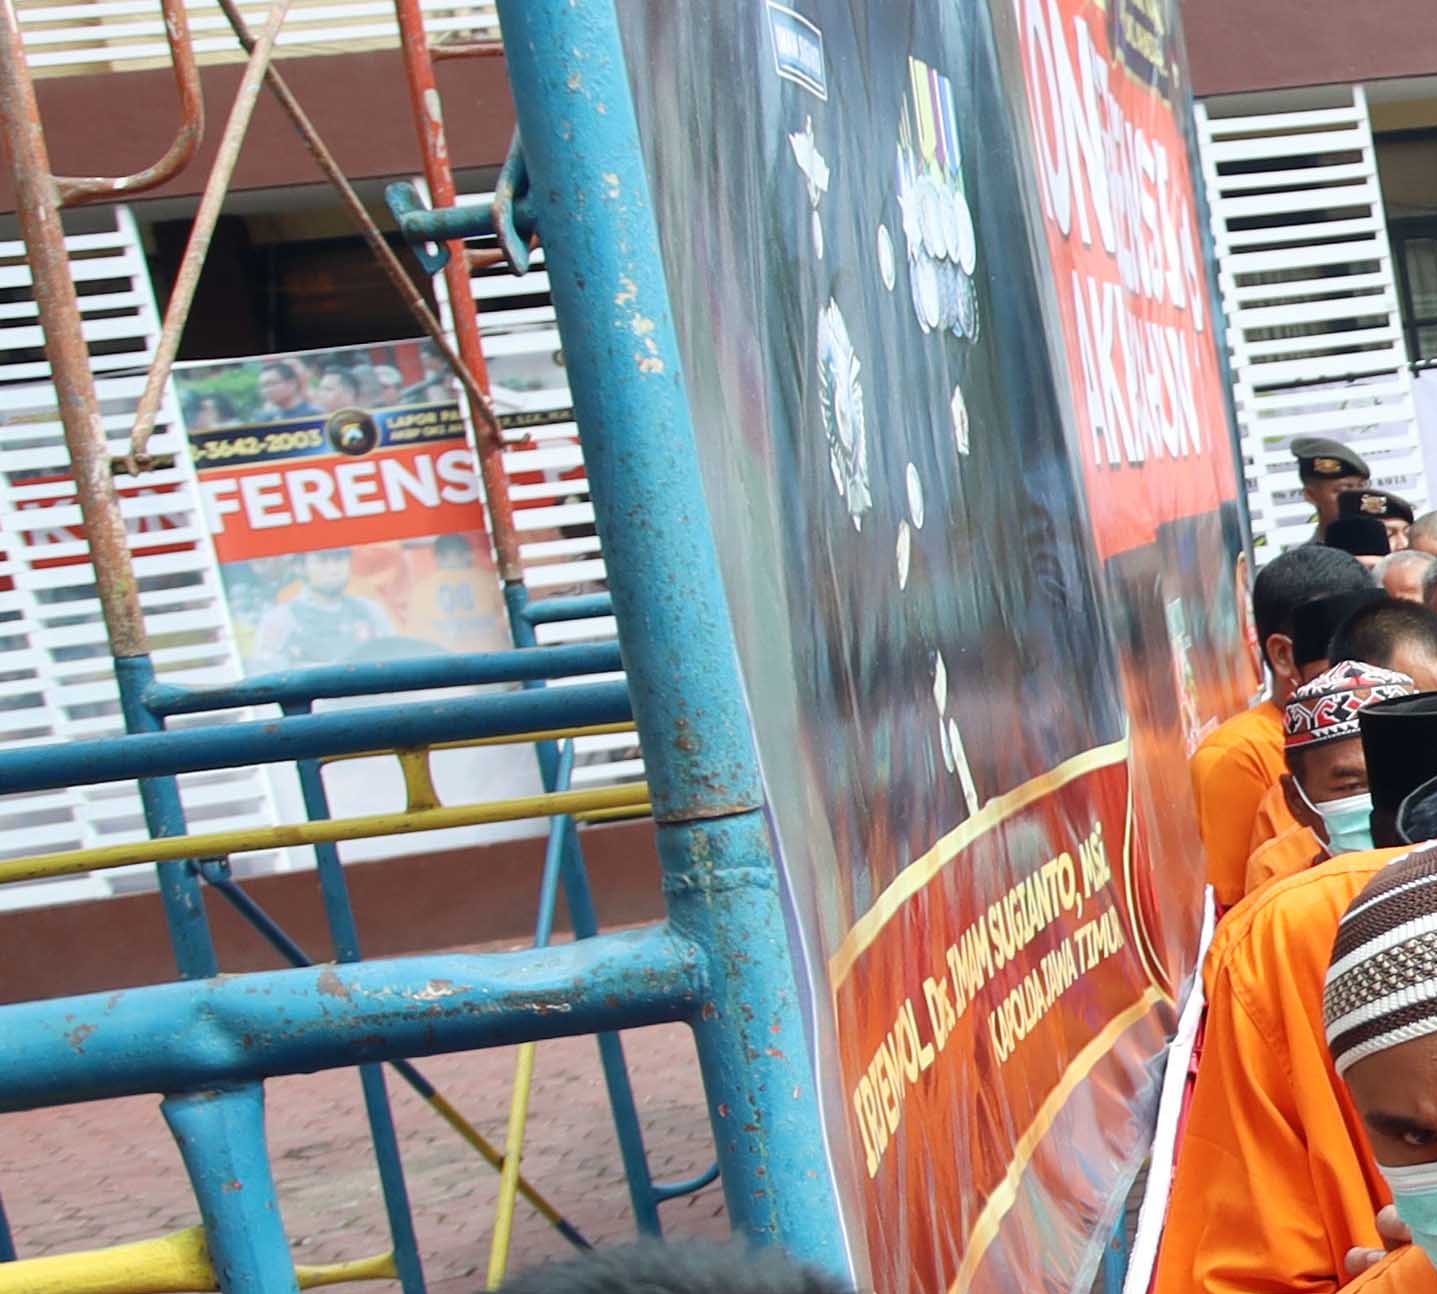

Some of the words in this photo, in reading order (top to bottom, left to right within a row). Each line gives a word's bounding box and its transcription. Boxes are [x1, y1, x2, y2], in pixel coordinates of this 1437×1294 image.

[946, 915, 995, 1018] IMAM
[988, 967, 1048, 1067] KAPOLDA
[1041, 937, 1079, 1008] JAWA
